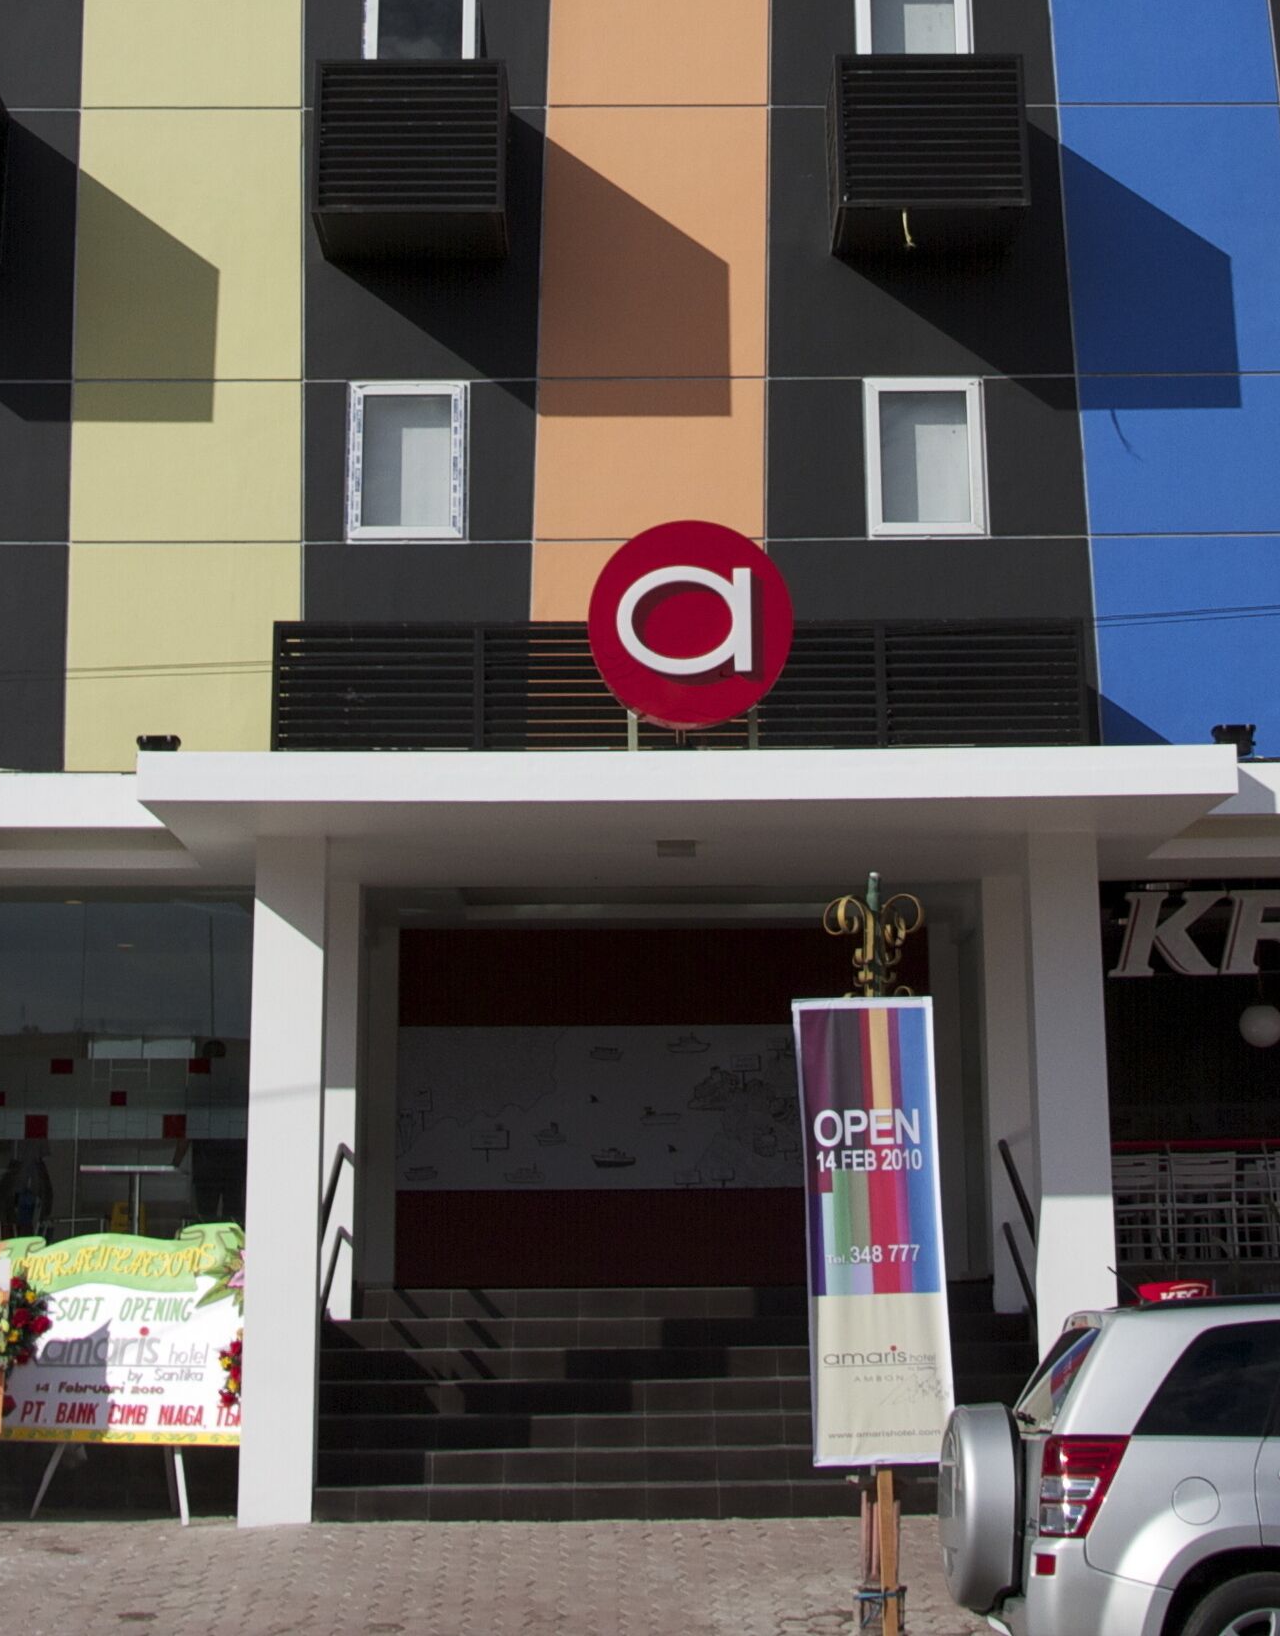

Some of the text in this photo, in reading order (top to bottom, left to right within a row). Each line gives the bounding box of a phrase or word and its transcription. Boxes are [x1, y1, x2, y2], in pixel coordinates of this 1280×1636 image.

[814, 1108, 920, 1147] OPEN
[816, 1149, 922, 1172] 14 FEB 2010
[850, 1245, 882, 1264] 348
[888, 1244, 920, 1263] 777
[54, 1296, 195, 1322] SOFT OPENING
[45, 1326, 209, 1365] amaris hotel
[823, 1345, 907, 1365] amaris
[127, 1367, 204, 1384] by Santika
[35, 1381, 164, 1395] 14 Februari 2010
[21, 1401, 47, 1423] PT.
[56, 1402, 99, 1424] BANK
[107, 1404, 149, 1426] CIMB
